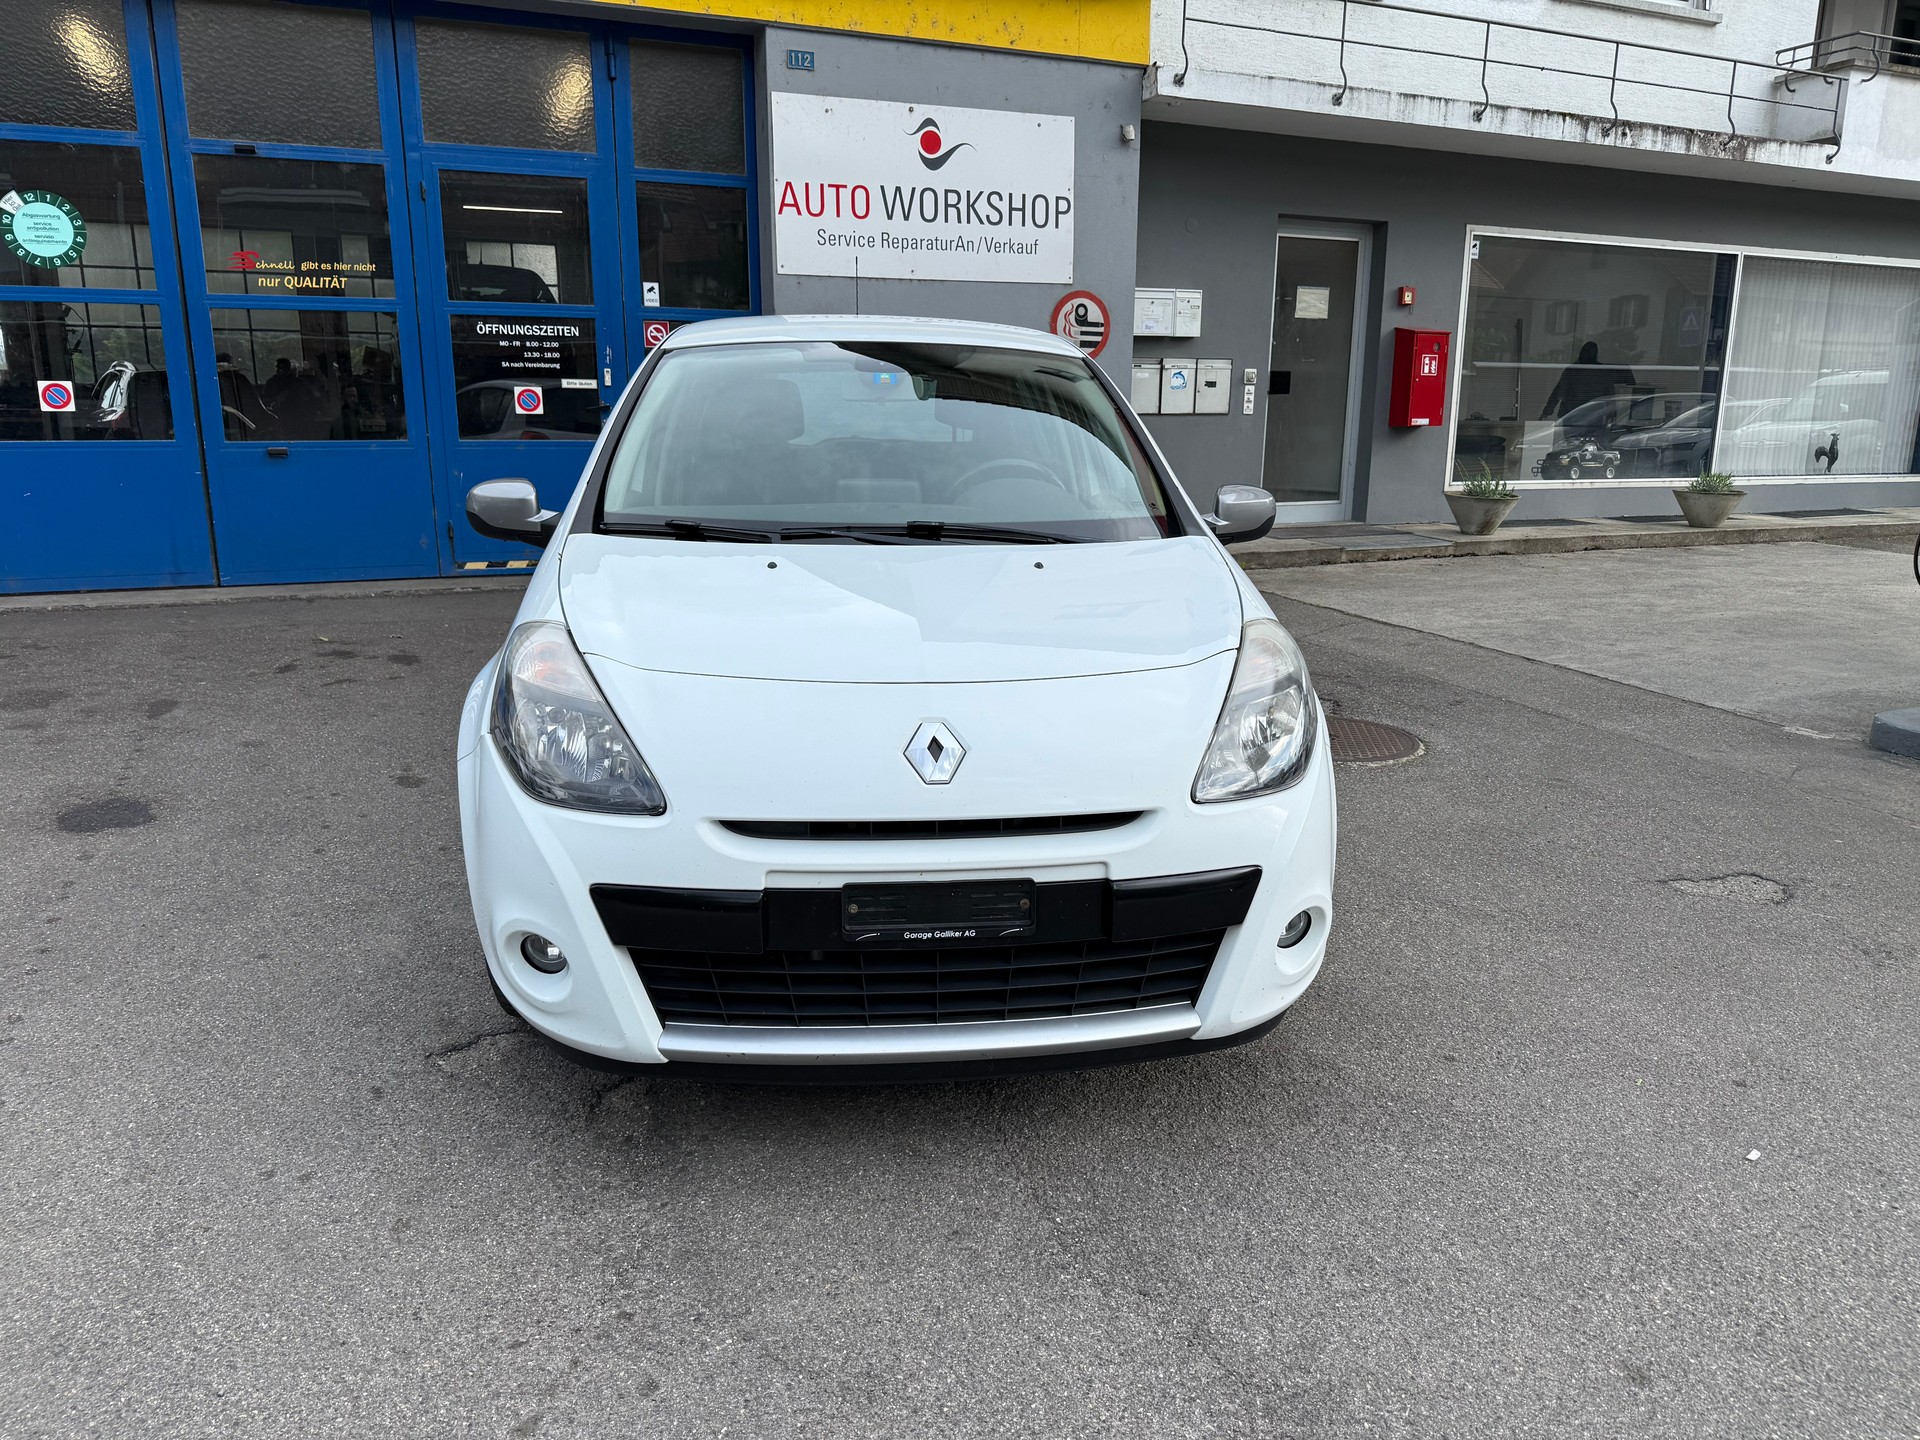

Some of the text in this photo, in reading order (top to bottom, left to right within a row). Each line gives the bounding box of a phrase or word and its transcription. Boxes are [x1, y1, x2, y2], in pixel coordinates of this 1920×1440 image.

[790, 52, 812, 68] 112
[24, 192, 35, 202] 12
[46, 194, 51, 202] 1
[62, 204, 70, 212] 2
[778, 180, 1072, 229] AUTO WORKSHOP
[2, 215, 11, 223] 10
[817, 228, 876, 248] Service
[17, 248, 25, 256] 8
[226, 250, 376, 272] Schnell gibt es hier nicht
[258, 275, 348, 290] nur QUALITÄT
[476, 321, 580, 337] ÖFFNUNGSZEITEN
[525, 361, 560, 369] Vereinbarung
[904, 929, 976, 939] Garage Galliker AG
